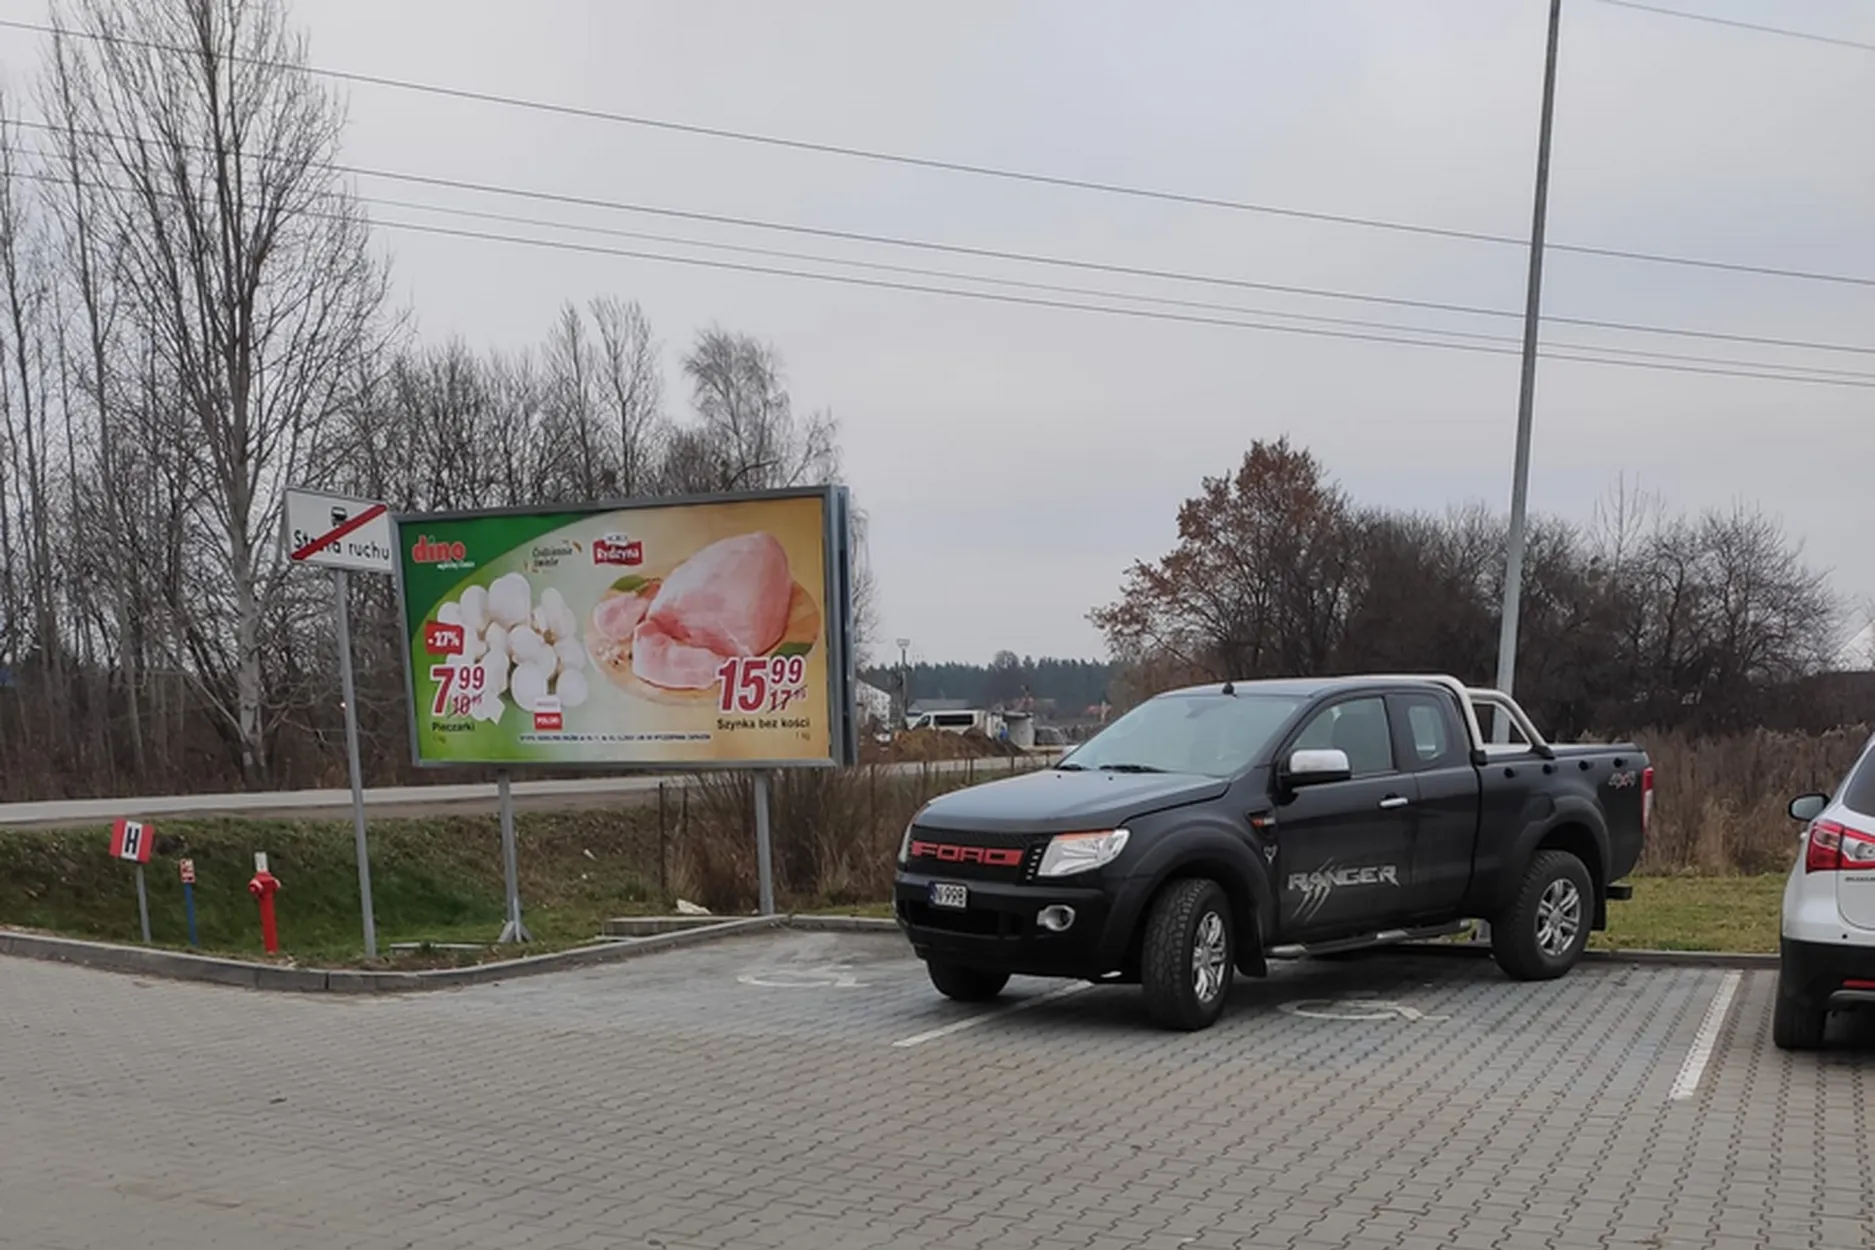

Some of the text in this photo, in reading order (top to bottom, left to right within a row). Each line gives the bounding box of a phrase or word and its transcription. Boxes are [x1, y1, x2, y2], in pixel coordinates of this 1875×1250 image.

[293, 529, 390, 560] Sta ruchu
[412, 535, 466, 563] dino
[717, 717, 810, 731] Szynka bez kości
[124, 826, 140, 855] H
[911, 840, 1025, 866] FORD
[1287, 865, 1402, 891] RANGER
